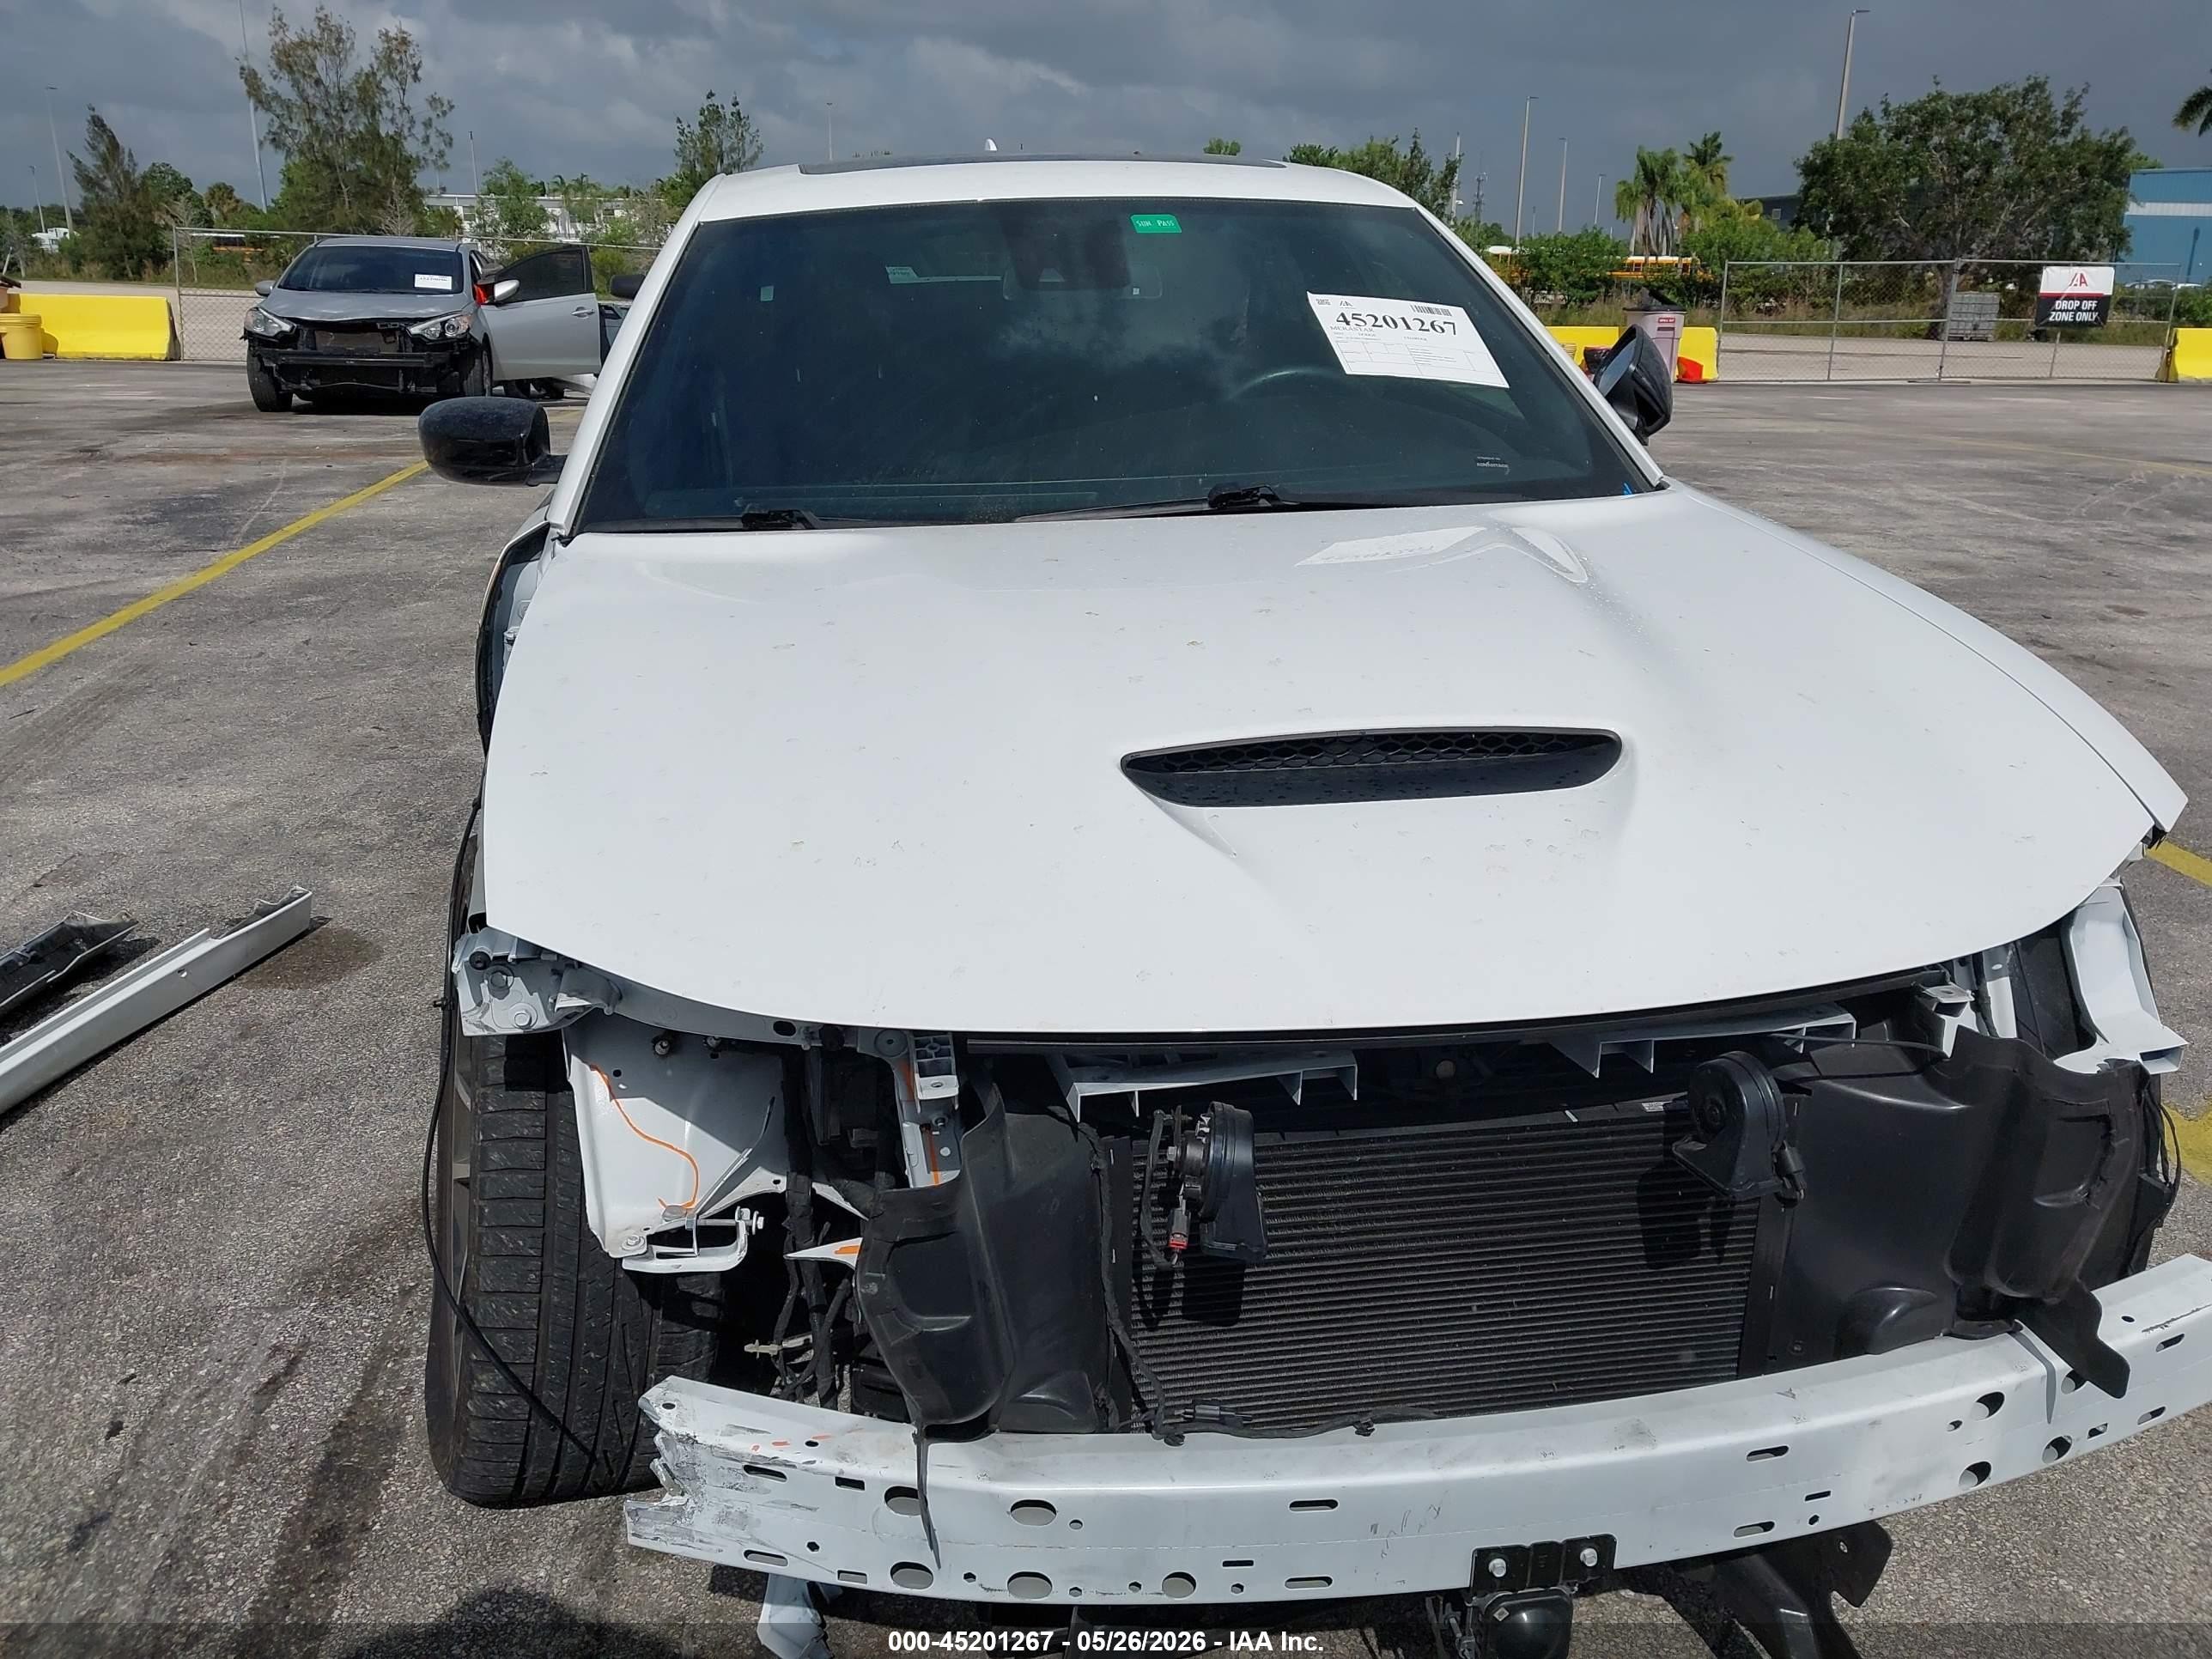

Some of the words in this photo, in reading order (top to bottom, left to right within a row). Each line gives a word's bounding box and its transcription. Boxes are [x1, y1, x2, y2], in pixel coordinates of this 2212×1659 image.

[2055, 301, 2081, 310] DROP
[2081, 301, 2099, 310] OFF
[2050, 312, 2074, 320] ZONE
[2075, 311, 2099, 321] ONLY
[1335, 312, 1457, 336] 45201267
